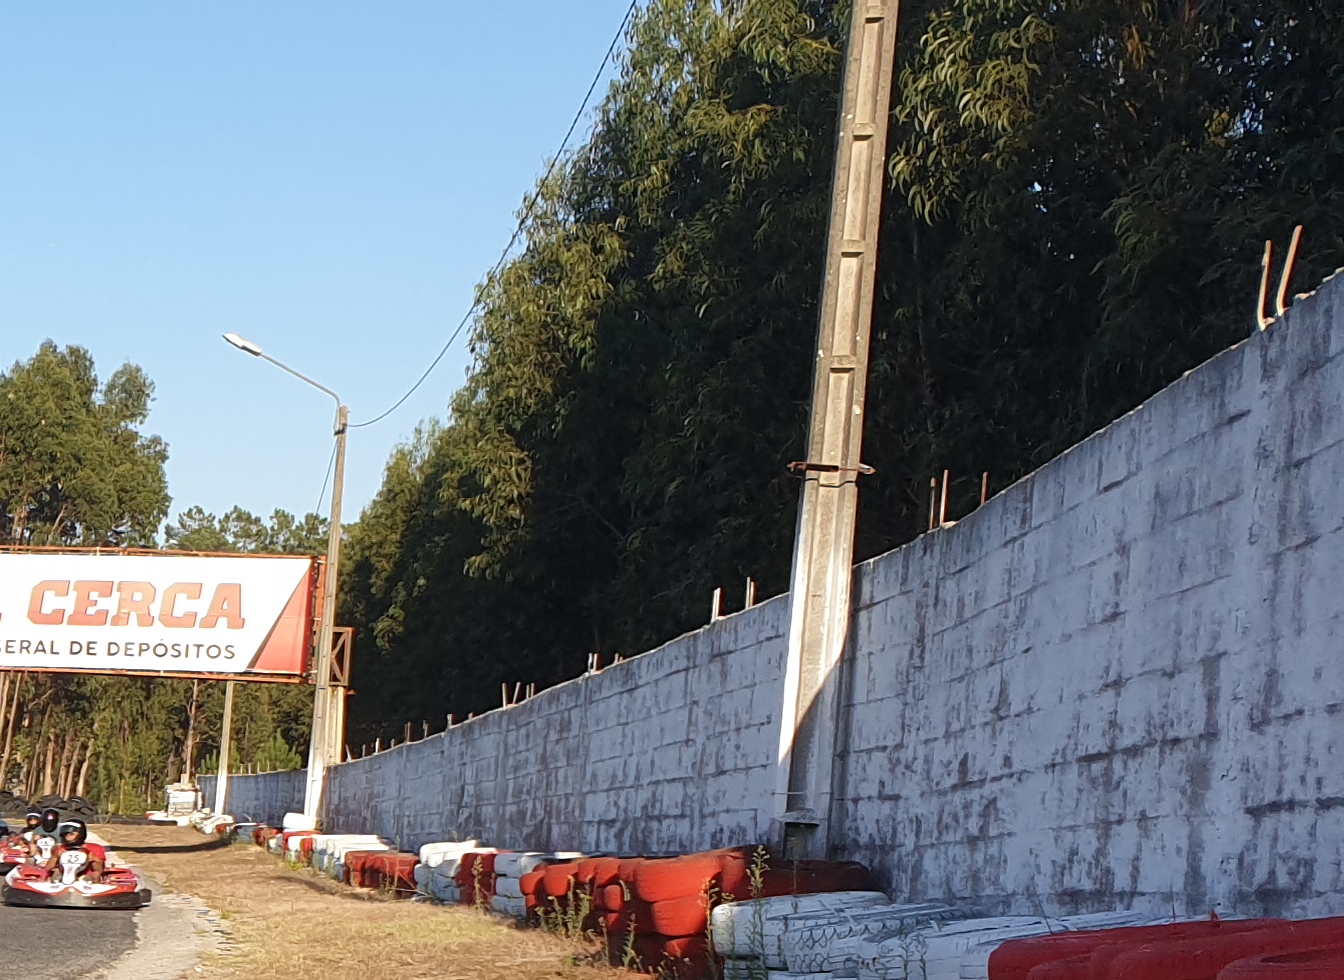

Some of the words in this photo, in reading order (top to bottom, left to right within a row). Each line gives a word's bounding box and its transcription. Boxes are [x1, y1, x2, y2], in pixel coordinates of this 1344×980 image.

[26, 579, 246, 630] CERCA
[69, 641, 98, 656] DE
[107, 638, 236, 660] DEPÓSITOS
[67, 854, 80, 864] 25
